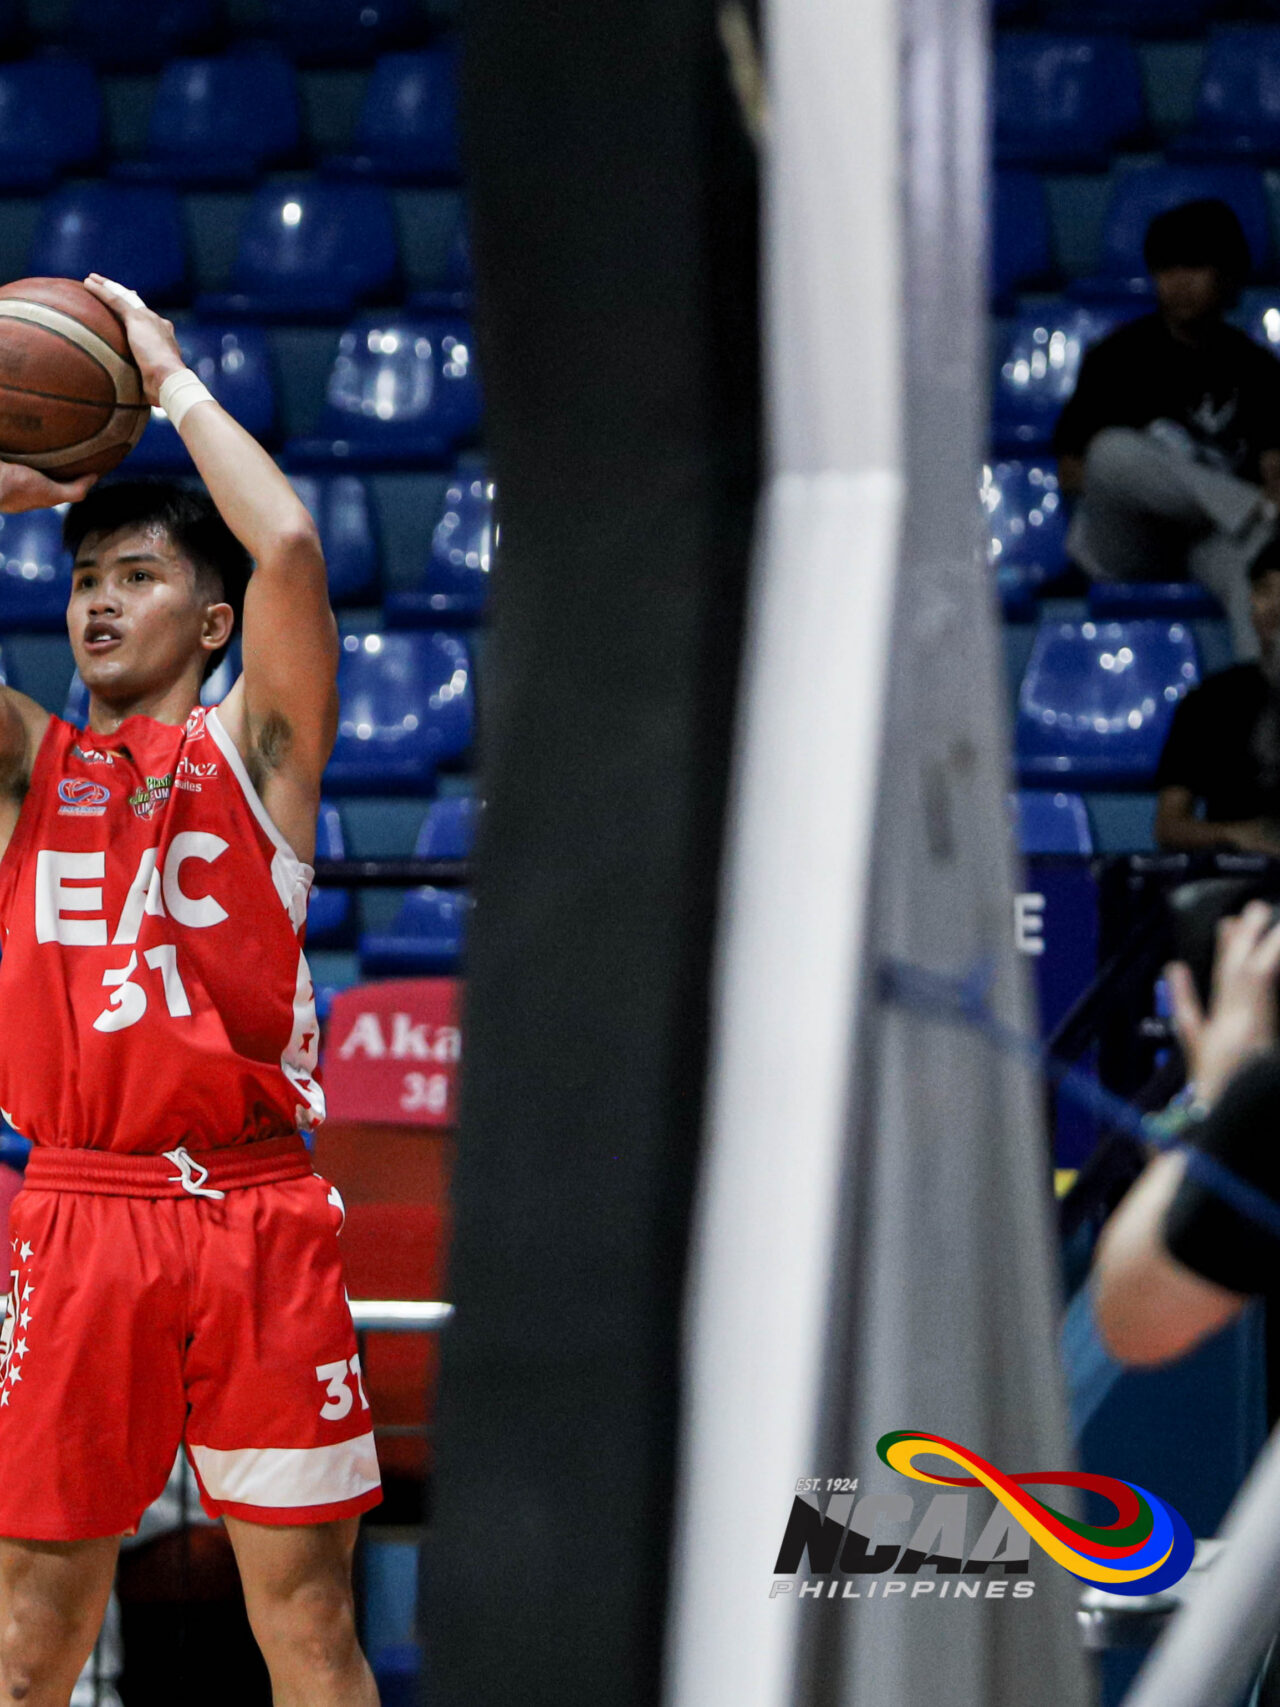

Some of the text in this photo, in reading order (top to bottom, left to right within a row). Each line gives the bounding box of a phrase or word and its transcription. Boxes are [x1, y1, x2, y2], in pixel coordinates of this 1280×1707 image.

[34, 830, 230, 947] EAC
[92, 943, 192, 1033] 31
[338, 1012, 462, 1062] Aka
[315, 1352, 370, 1421] 31
